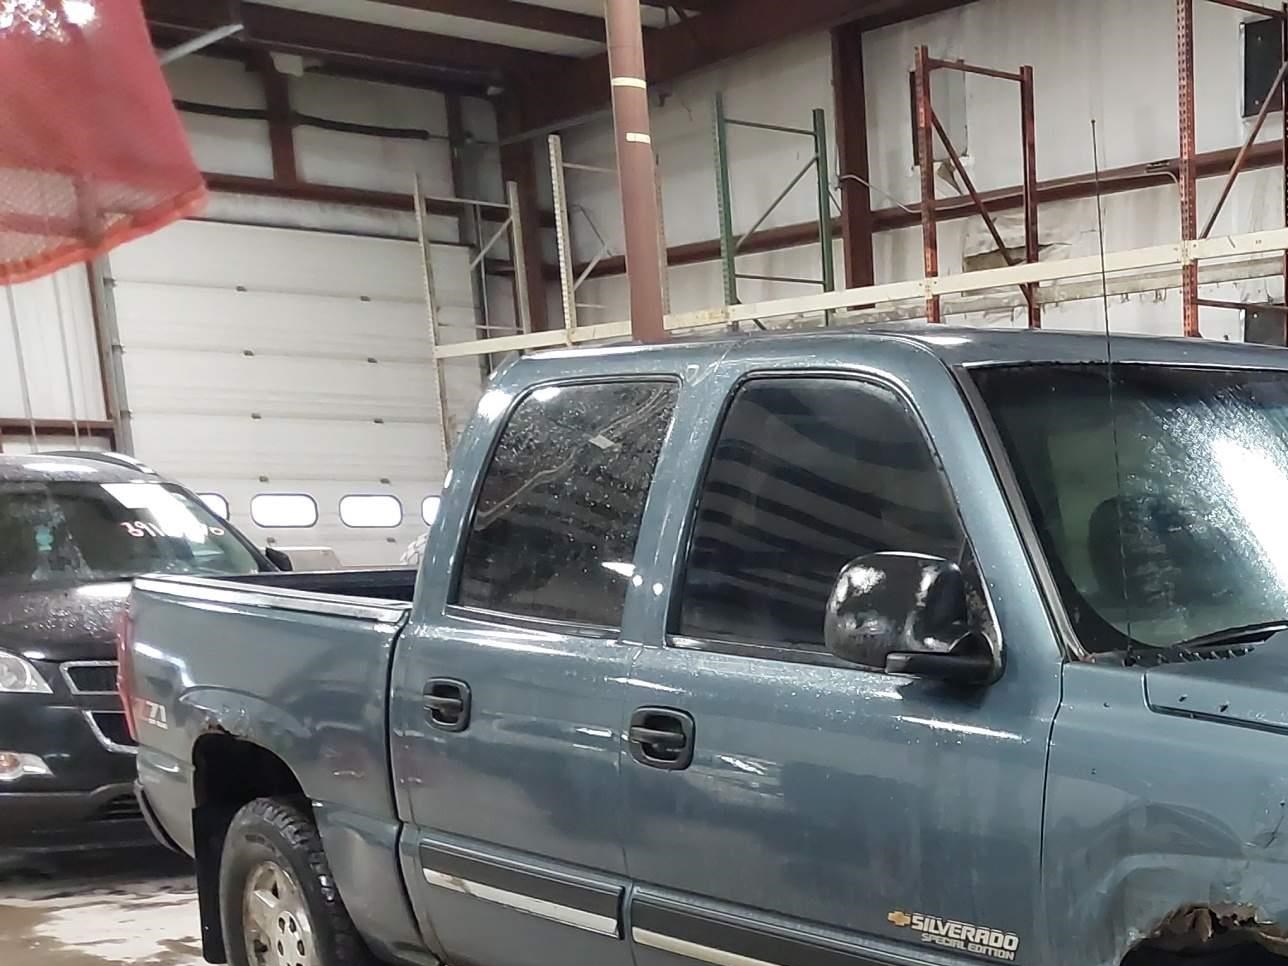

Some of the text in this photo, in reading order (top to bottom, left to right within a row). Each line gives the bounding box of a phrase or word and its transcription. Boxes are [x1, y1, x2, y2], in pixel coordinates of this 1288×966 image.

[911, 913, 1019, 951] SILVERADO
[921, 932, 1015, 960] SPECIAL EDITION
